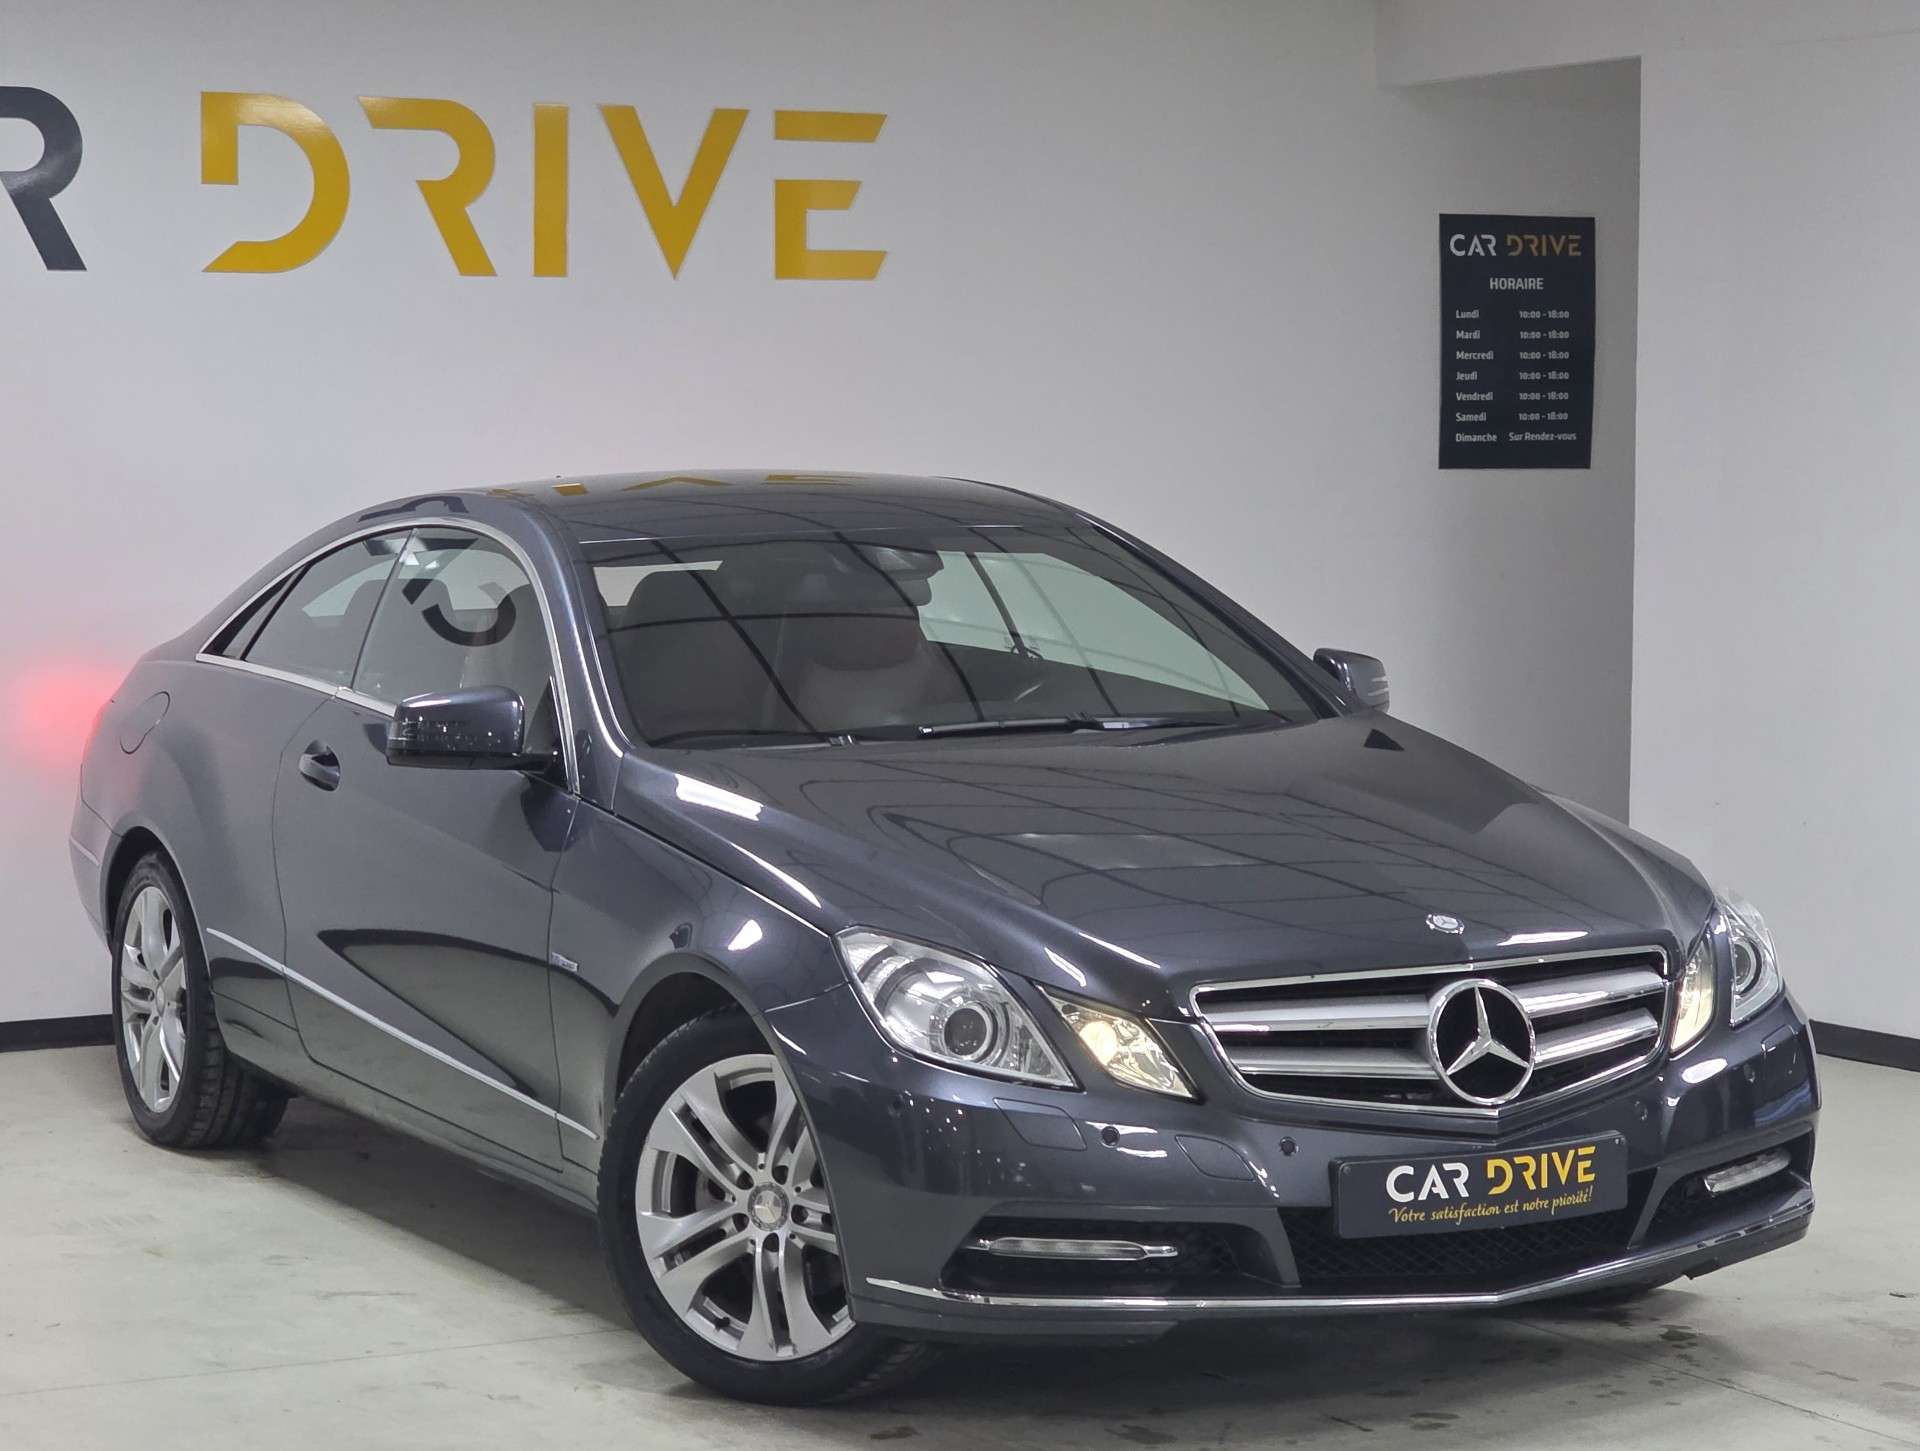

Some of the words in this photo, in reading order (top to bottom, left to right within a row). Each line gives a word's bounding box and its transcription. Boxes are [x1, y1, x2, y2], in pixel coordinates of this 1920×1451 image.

[200, 91, 888, 280] DRIVE
[1450, 234, 1497, 256] CAR
[1506, 234, 1582, 256] DRIVE
[1489, 277, 1544, 290] HORAIRE
[1455, 309, 1479, 319] Lundi
[1519, 310, 1541, 319] 10:00
[1455, 329, 1480, 339] Mardi
[1519, 330, 1541, 339] 10:00
[1455, 350, 1494, 360] Mercredi
[1519, 351, 1541, 360] 10:00
[1455, 371, 1478, 381] Jeudi
[1519, 371, 1541, 380] 10:00
[1455, 391, 1494, 401] Vendredi
[1519, 391, 1541, 400] 10:00
[1455, 412, 1487, 422] Samedi
[1518, 412, 1540, 421] 10:00
[1455, 432, 1497, 442] Dimanche
[1508, 432, 1523, 441] Sur
[1525, 431, 1577, 442] Rendez-vous
[1386, 1162, 1470, 1203] CAR
[1487, 1146, 1597, 1196] DRIVE
[1388, 1205, 1425, 1224] Votre
[1430, 1204, 1500, 1226] satisfaction
[1504, 1199, 1519, 1214] est
[1522, 1198, 1550, 1213] notre
